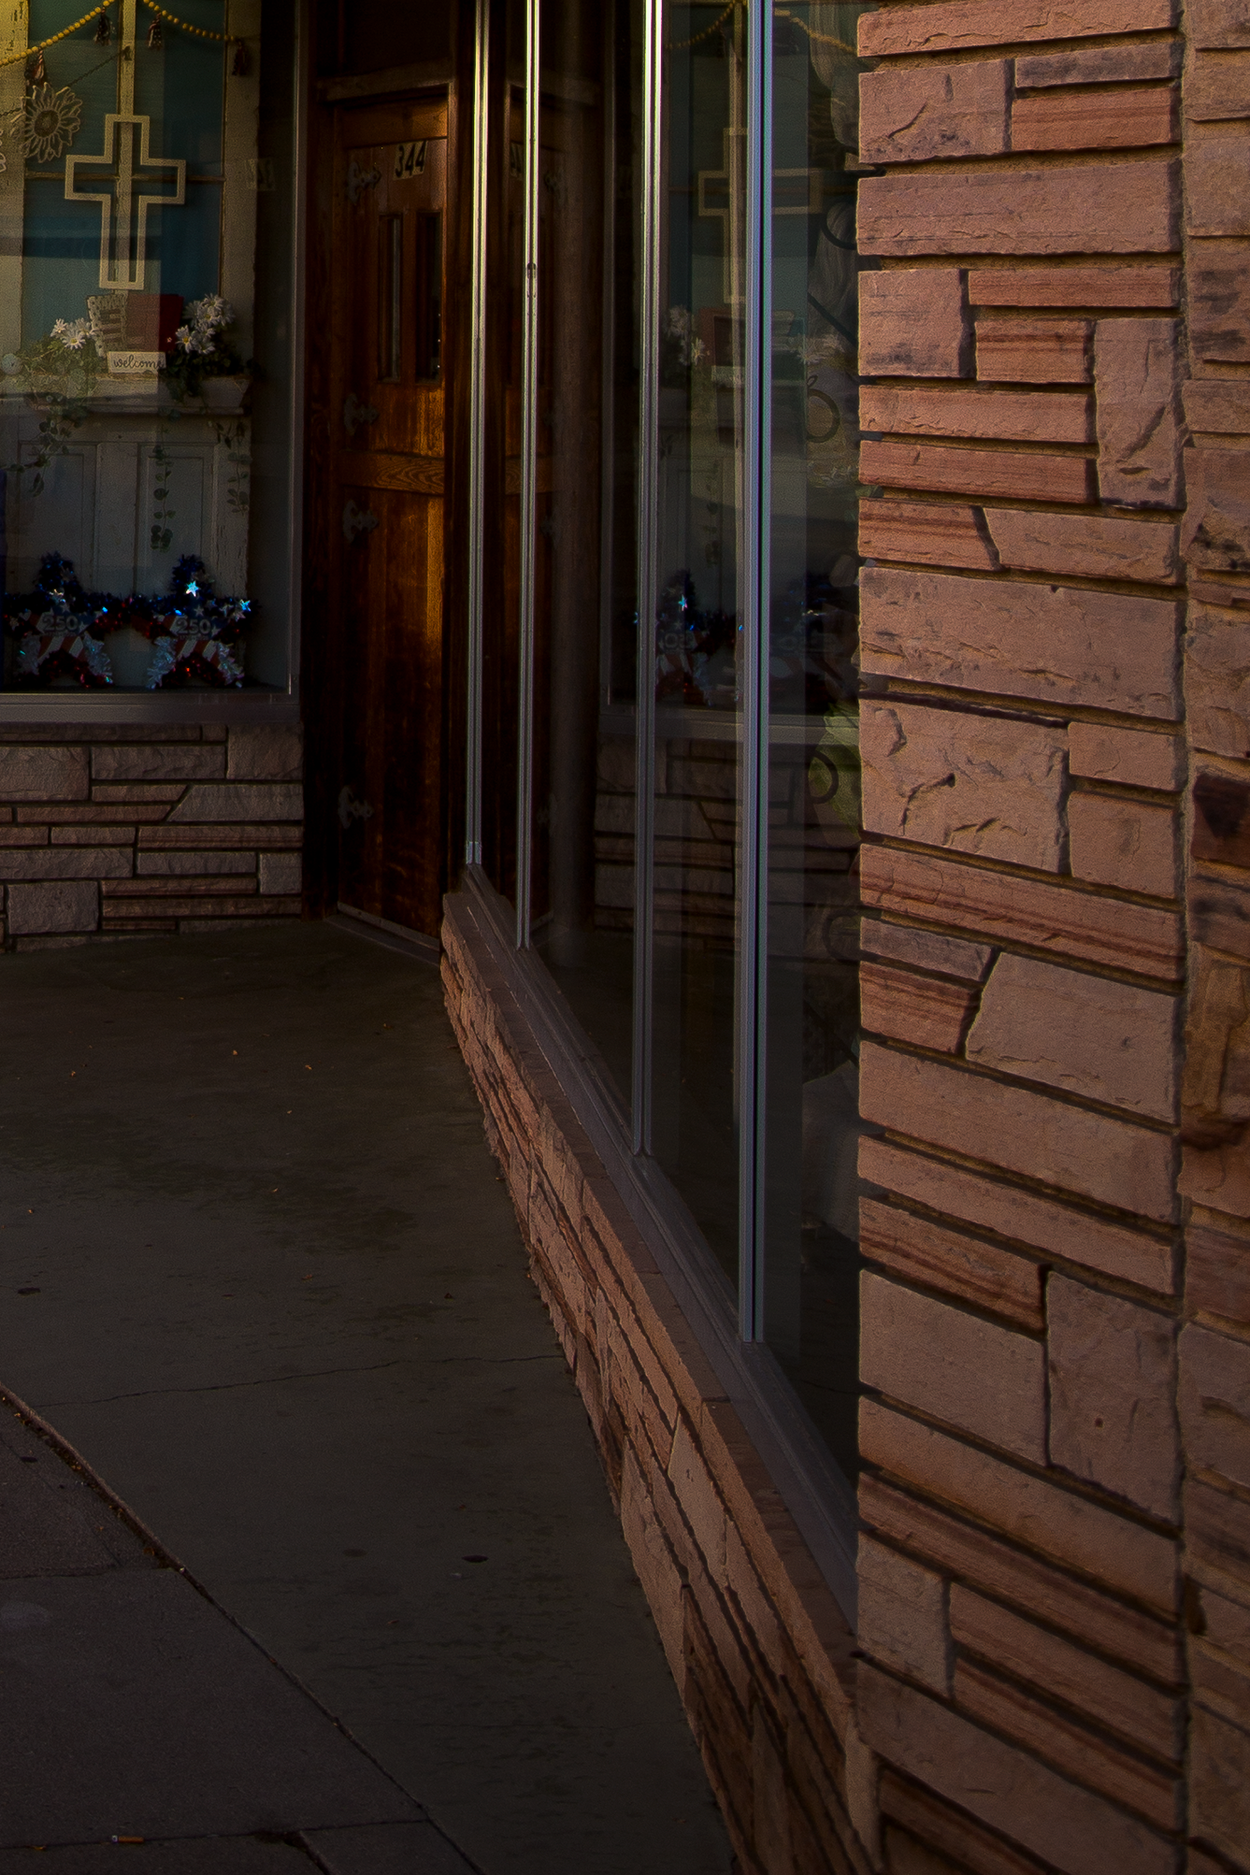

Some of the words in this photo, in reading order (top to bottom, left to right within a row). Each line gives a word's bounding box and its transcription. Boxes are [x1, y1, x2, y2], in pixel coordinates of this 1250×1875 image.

[395, 141, 427, 178] 344
[43, 614, 78, 632] 250
[176, 618, 211, 636] 250
